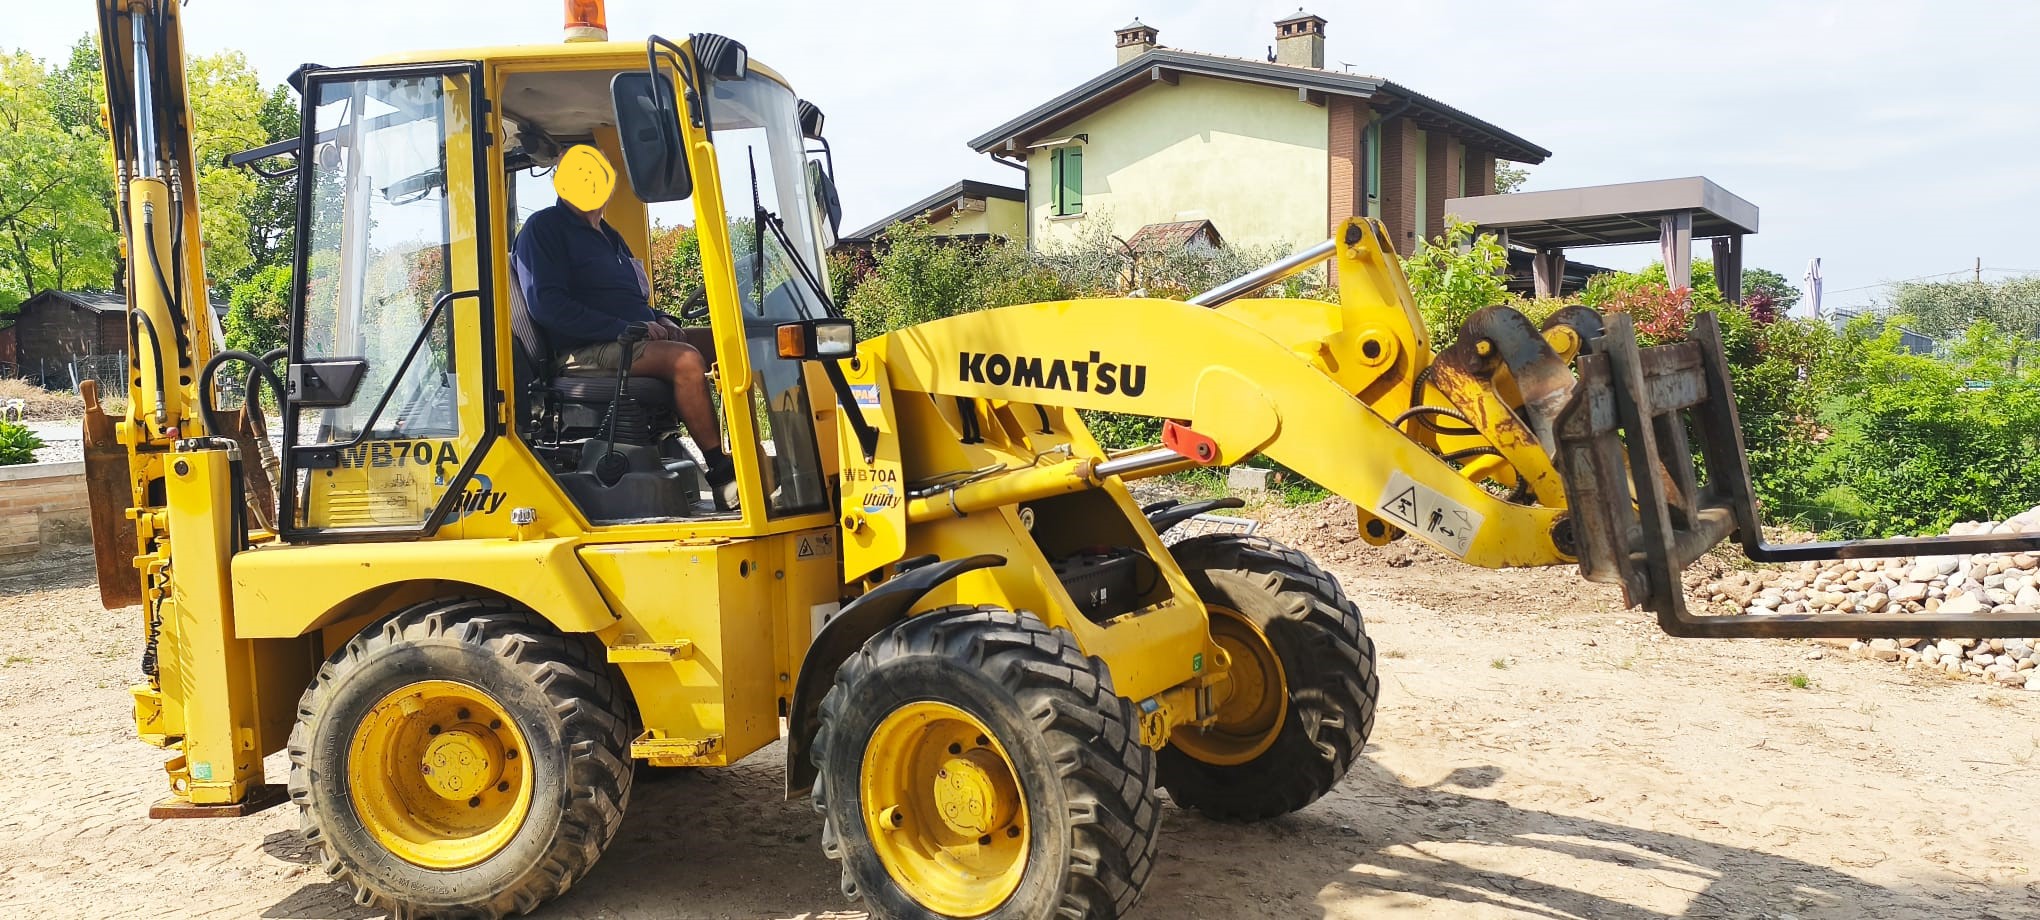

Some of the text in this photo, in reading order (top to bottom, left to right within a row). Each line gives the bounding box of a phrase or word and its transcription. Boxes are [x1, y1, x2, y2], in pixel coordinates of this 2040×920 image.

[959, 350, 1147, 397] KOMATSU
[338, 441, 459, 469] WB70A
[843, 468, 897, 483] WB70A
[450, 489, 507, 515] ility
[862, 492, 902, 510] Utility
